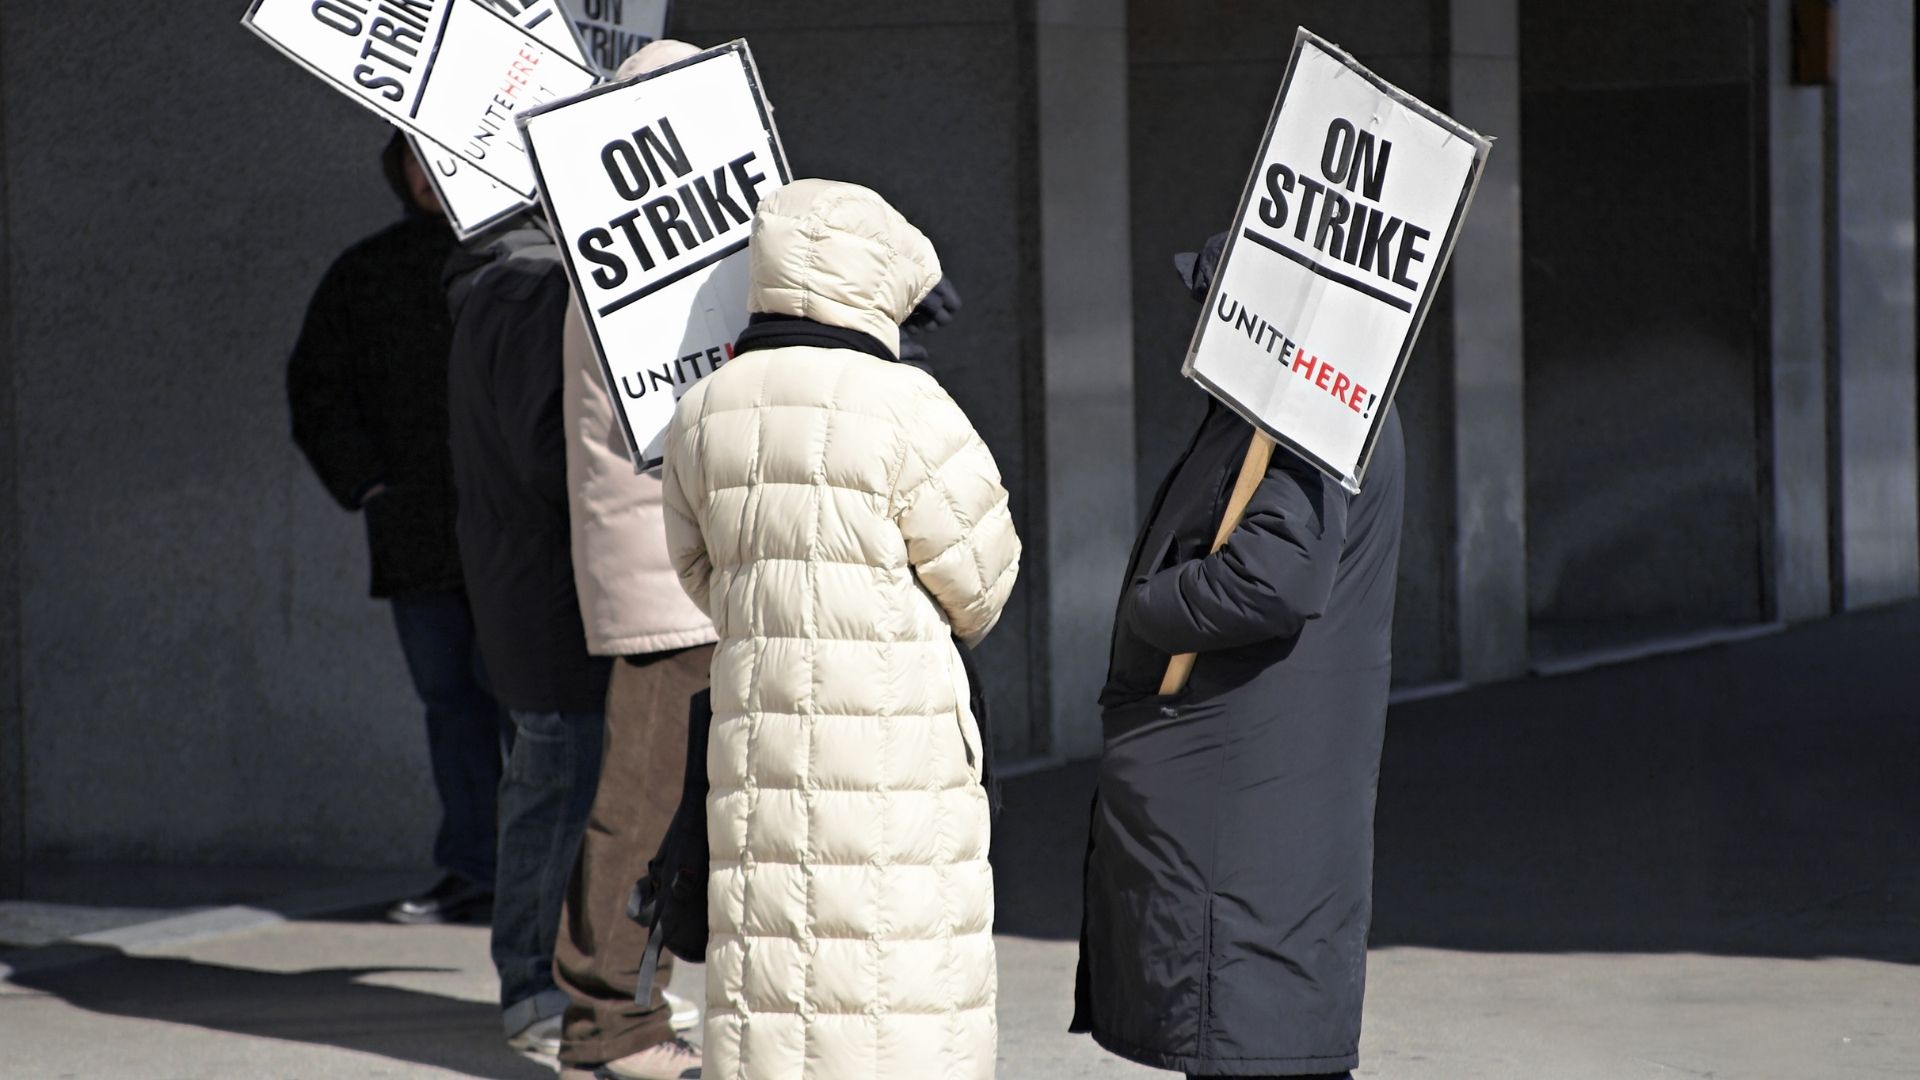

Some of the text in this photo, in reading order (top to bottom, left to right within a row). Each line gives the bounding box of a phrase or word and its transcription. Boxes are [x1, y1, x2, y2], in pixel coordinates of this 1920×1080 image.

[353, 0, 435, 102] STRIK
[601, 117, 693, 201] ON
[1320, 117, 1392, 203] ON
[577, 151, 767, 290] STRIKE
[1259, 163, 1431, 291] STRIKE
[1217, 292, 1377, 419] UNITEHERE!
